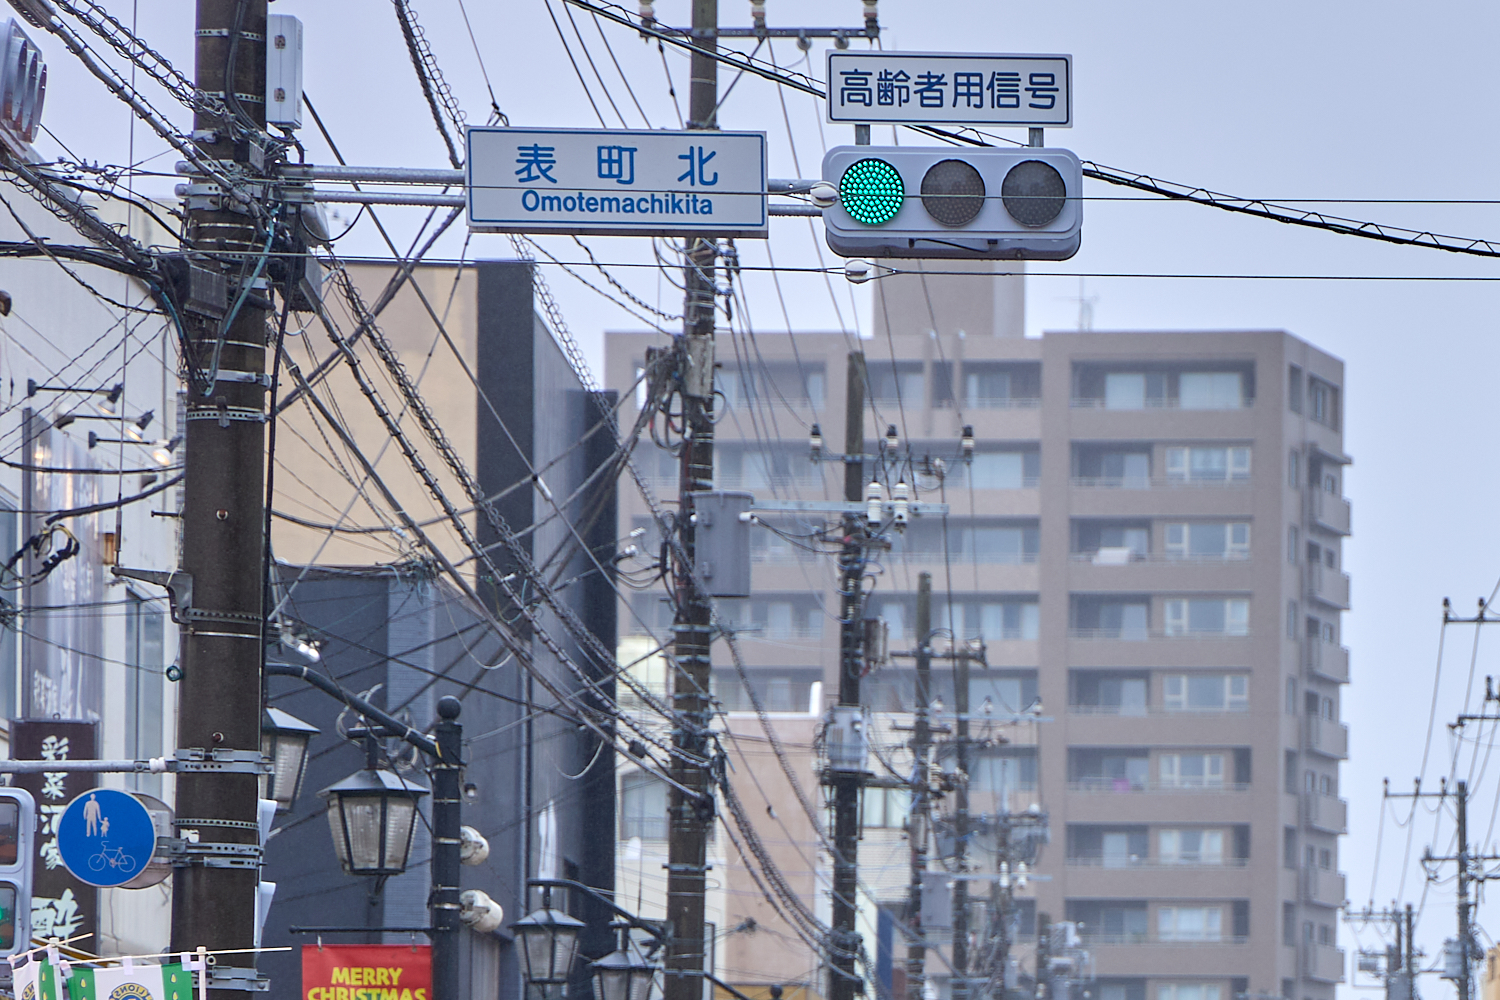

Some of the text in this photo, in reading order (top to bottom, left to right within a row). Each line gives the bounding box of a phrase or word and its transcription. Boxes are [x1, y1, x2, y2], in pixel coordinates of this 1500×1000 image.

[838, 68, 1060, 111] 高齢者用信号
[514, 144, 719, 188] 表町北
[520, 188, 713, 216] Omotemachikita
[331, 967, 403, 986] MERRY
